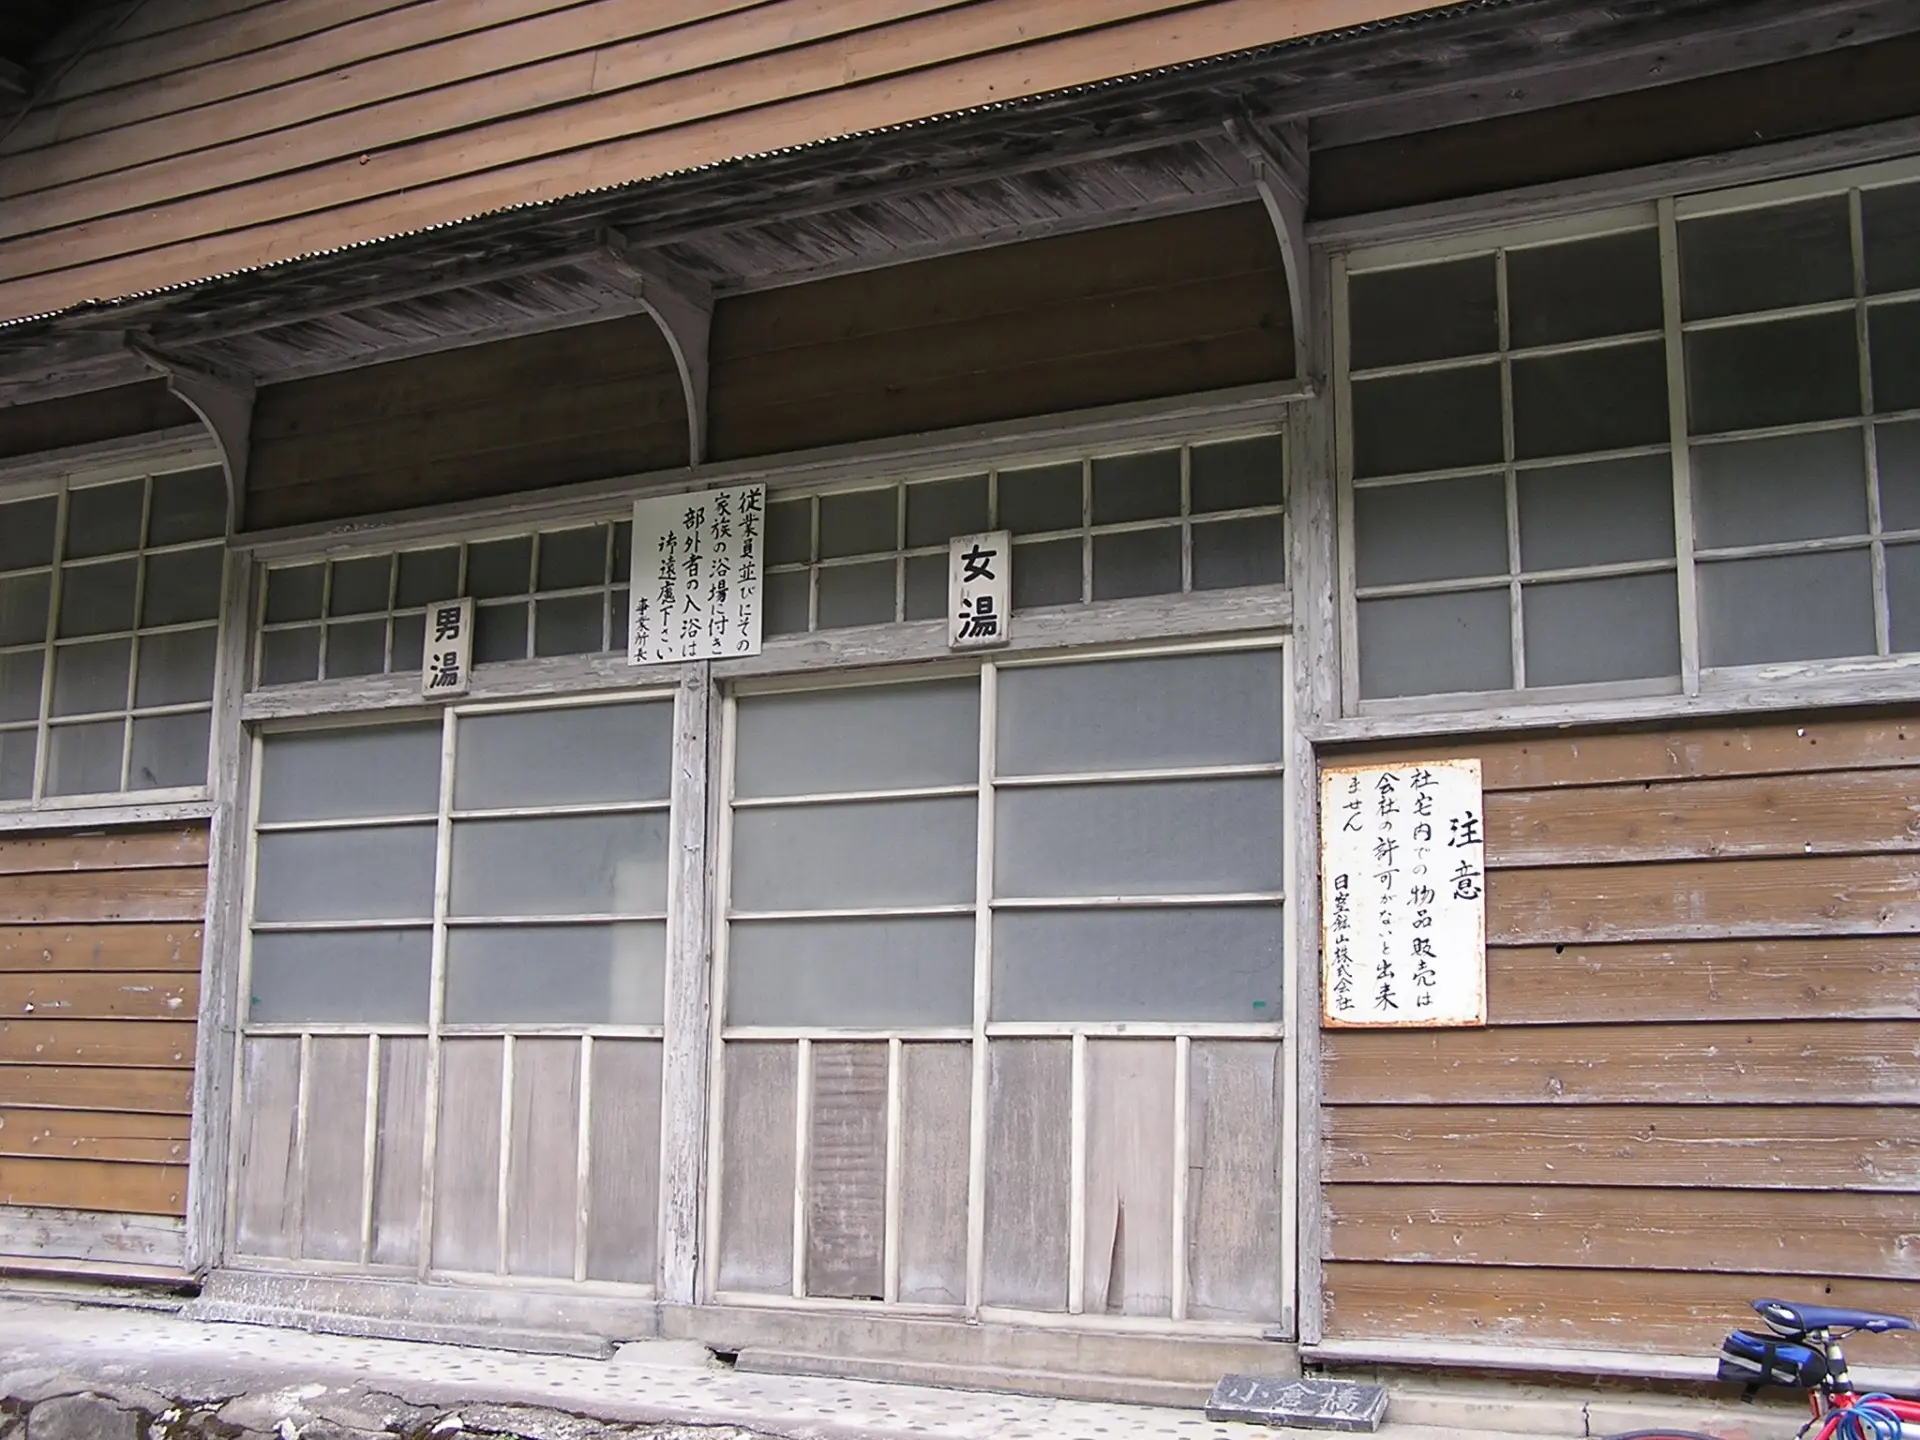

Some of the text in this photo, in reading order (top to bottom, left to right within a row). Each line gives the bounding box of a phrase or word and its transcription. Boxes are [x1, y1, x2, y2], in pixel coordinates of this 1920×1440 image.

[680, 507, 705, 657] 部外者の入浴は
[707, 492, 732, 655] 家族の浴場に付き
[737, 488, 762, 651] 従業員並びにその
[958, 544, 997, 639] 女湯
[430, 606, 461, 689] 男湯
[1342, 777, 1364, 832] ません
[1448, 811, 1483, 900] 注意
[1373, 772, 1400, 1010] 会社の許可がないと出来
[1406, 768, 1439, 1007] 社宅内での物品販売は
